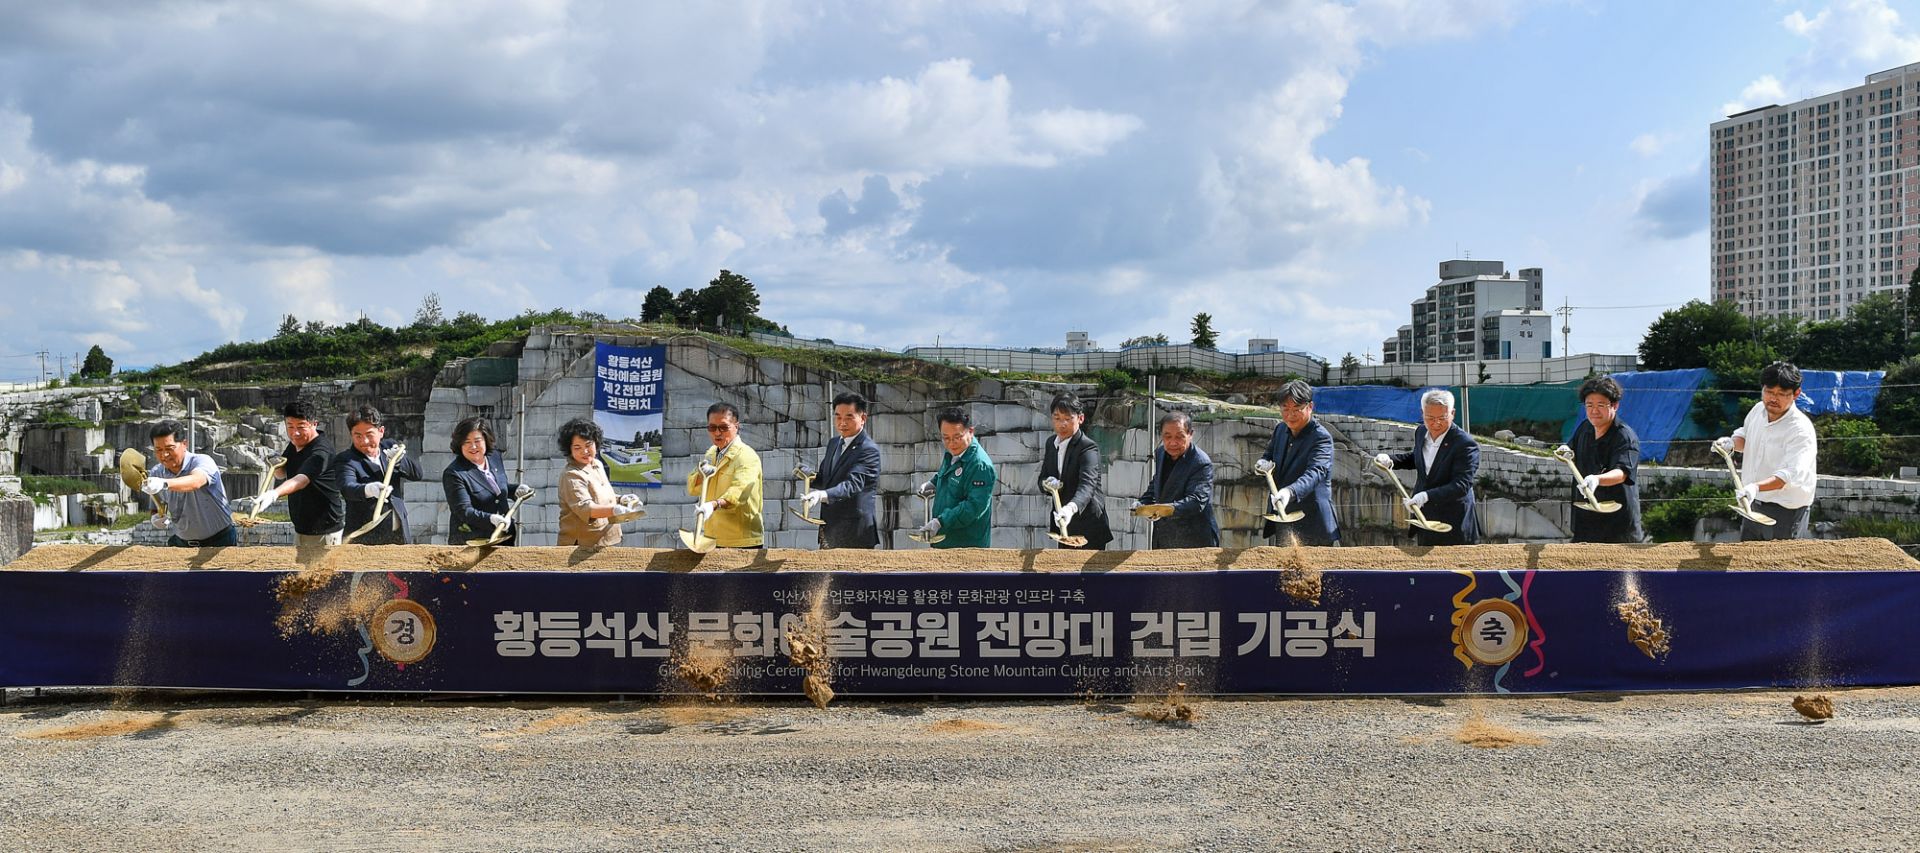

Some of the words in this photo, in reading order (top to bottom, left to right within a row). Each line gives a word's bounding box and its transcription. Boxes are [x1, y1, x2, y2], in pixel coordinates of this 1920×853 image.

[608, 354, 653, 369] 황등석산
[597, 365, 663, 383] 문화예술공원
[622, 383, 656, 397] 전망대
[815, 589, 909, 605] 업문화자원을
[912, 589, 953, 605] 활용한
[957, 589, 1011, 605] 문화관광
[1015, 589, 1055, 604] 인프라
[1059, 589, 1086, 605] 구축
[391, 617, 415, 645] 경
[494, 610, 674, 658] 황등석산
[976, 611, 1114, 658] 전망대
[1130, 611, 1221, 658] 건립
[1237, 611, 1376, 658] 기공식
[1480, 617, 1507, 645] 축
[838, 664, 857, 677] for
[861, 664, 946, 679] Hwangdeung
[950, 664, 989, 677] Stone
[994, 664, 1056, 677] Mountain
[1060, 664, 1109, 677] Culture
[1114, 664, 1138, 677] and
[1143, 664, 1171, 677] Arts
[1175, 664, 1205, 677] Park
